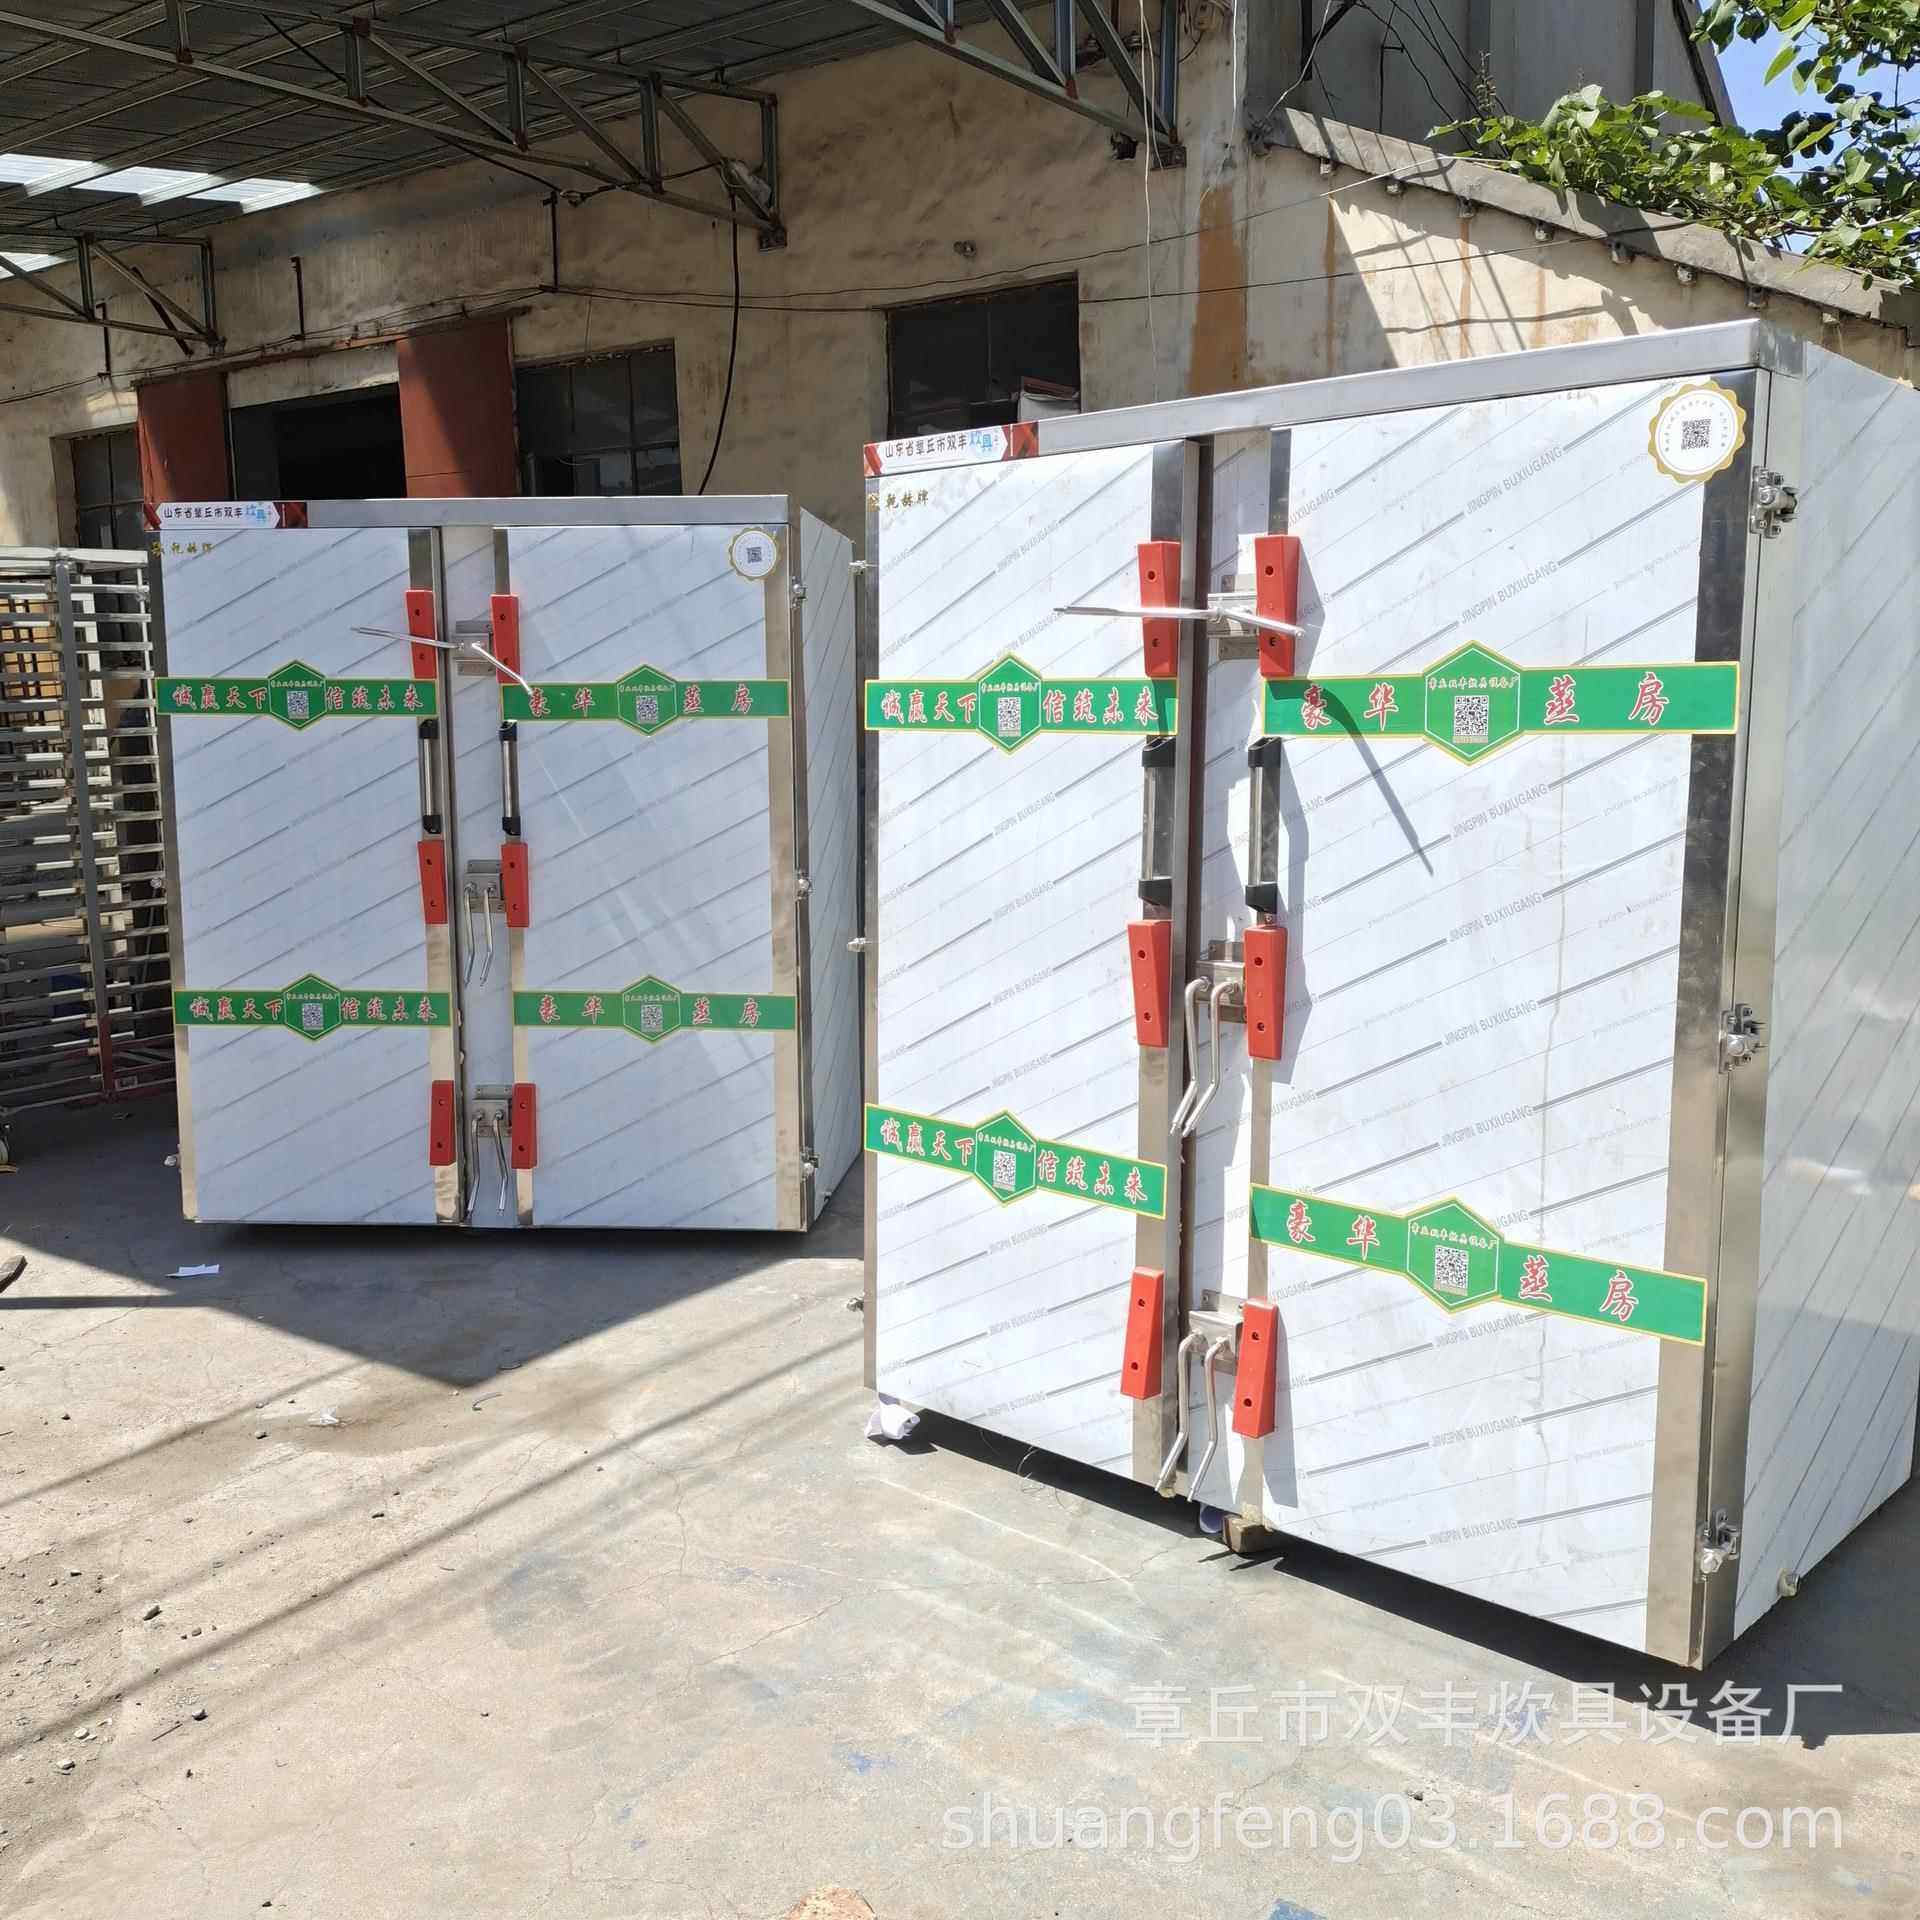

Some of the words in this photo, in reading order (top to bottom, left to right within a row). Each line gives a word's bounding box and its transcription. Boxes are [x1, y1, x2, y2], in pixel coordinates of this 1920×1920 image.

[172, 684, 267, 711] 诚赢天下
[880, 688, 977, 725] 诚赢天下
[1042, 686, 1158, 725] 信筑未来
[1302, 682, 1399, 732] 豪华
[1543, 671, 1670, 726] 蒸房
[880, 1117, 975, 1167] 诚赢天下
[1037, 1150, 1147, 1204] 信筑未来
[1286, 1199, 1381, 1262] 豪华
[1519, 1254, 1639, 1322] 蒸房
